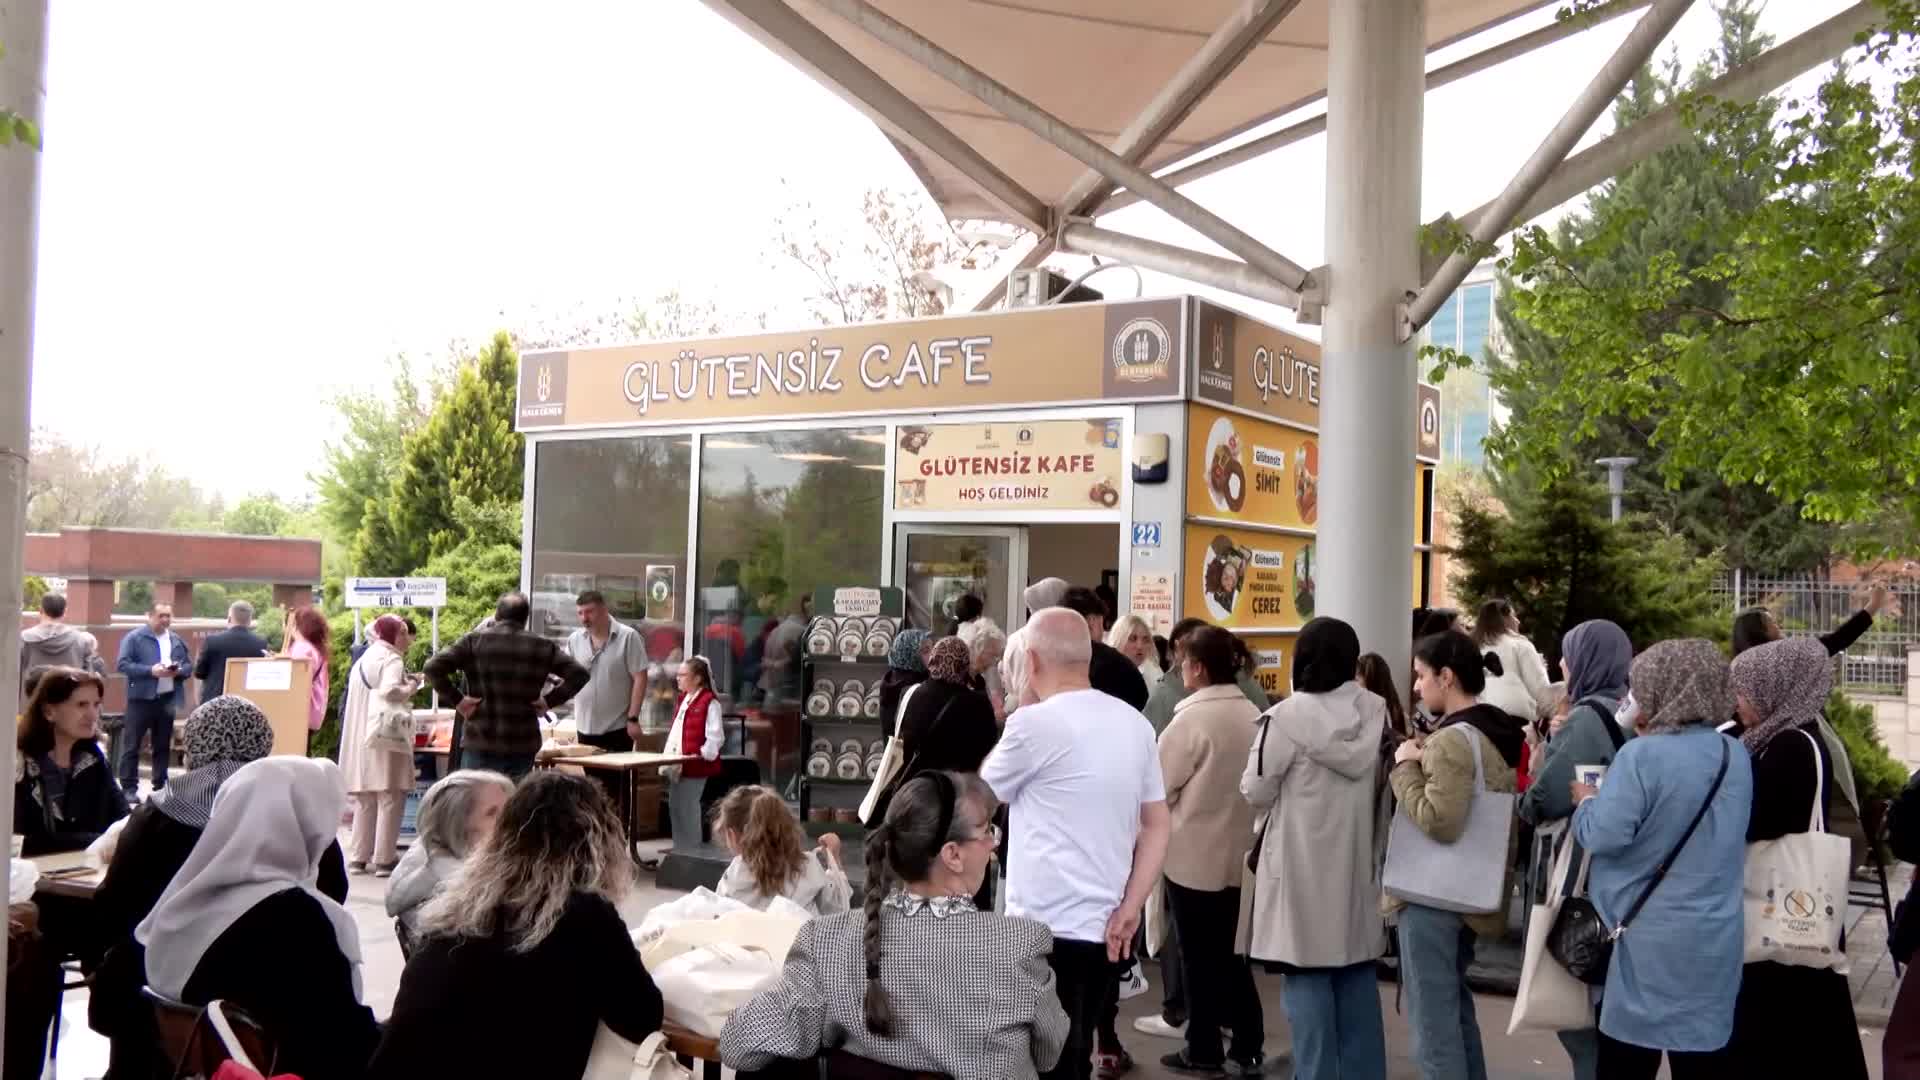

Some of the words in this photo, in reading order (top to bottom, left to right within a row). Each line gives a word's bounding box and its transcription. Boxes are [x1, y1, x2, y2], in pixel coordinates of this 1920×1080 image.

[623, 337, 844, 416] GLÜTENSİZ
[859, 335, 992, 390] CAFE
[920, 451, 1031, 476] GLÜTENSİZ
[1037, 454, 1095, 474] KAFE
[1255, 450, 1281, 467] Glütensiz
[1255, 470, 1281, 494] SİMİT
[959, 486, 985, 502] HOŞ
[988, 485, 1049, 499] GELDİNİZ
[1137, 524, 1156, 544] 22
[1254, 553, 1280, 566] Glütensiz
[403, 596, 413, 605] AL
[1252, 597, 1281, 618] ÇEREZ
